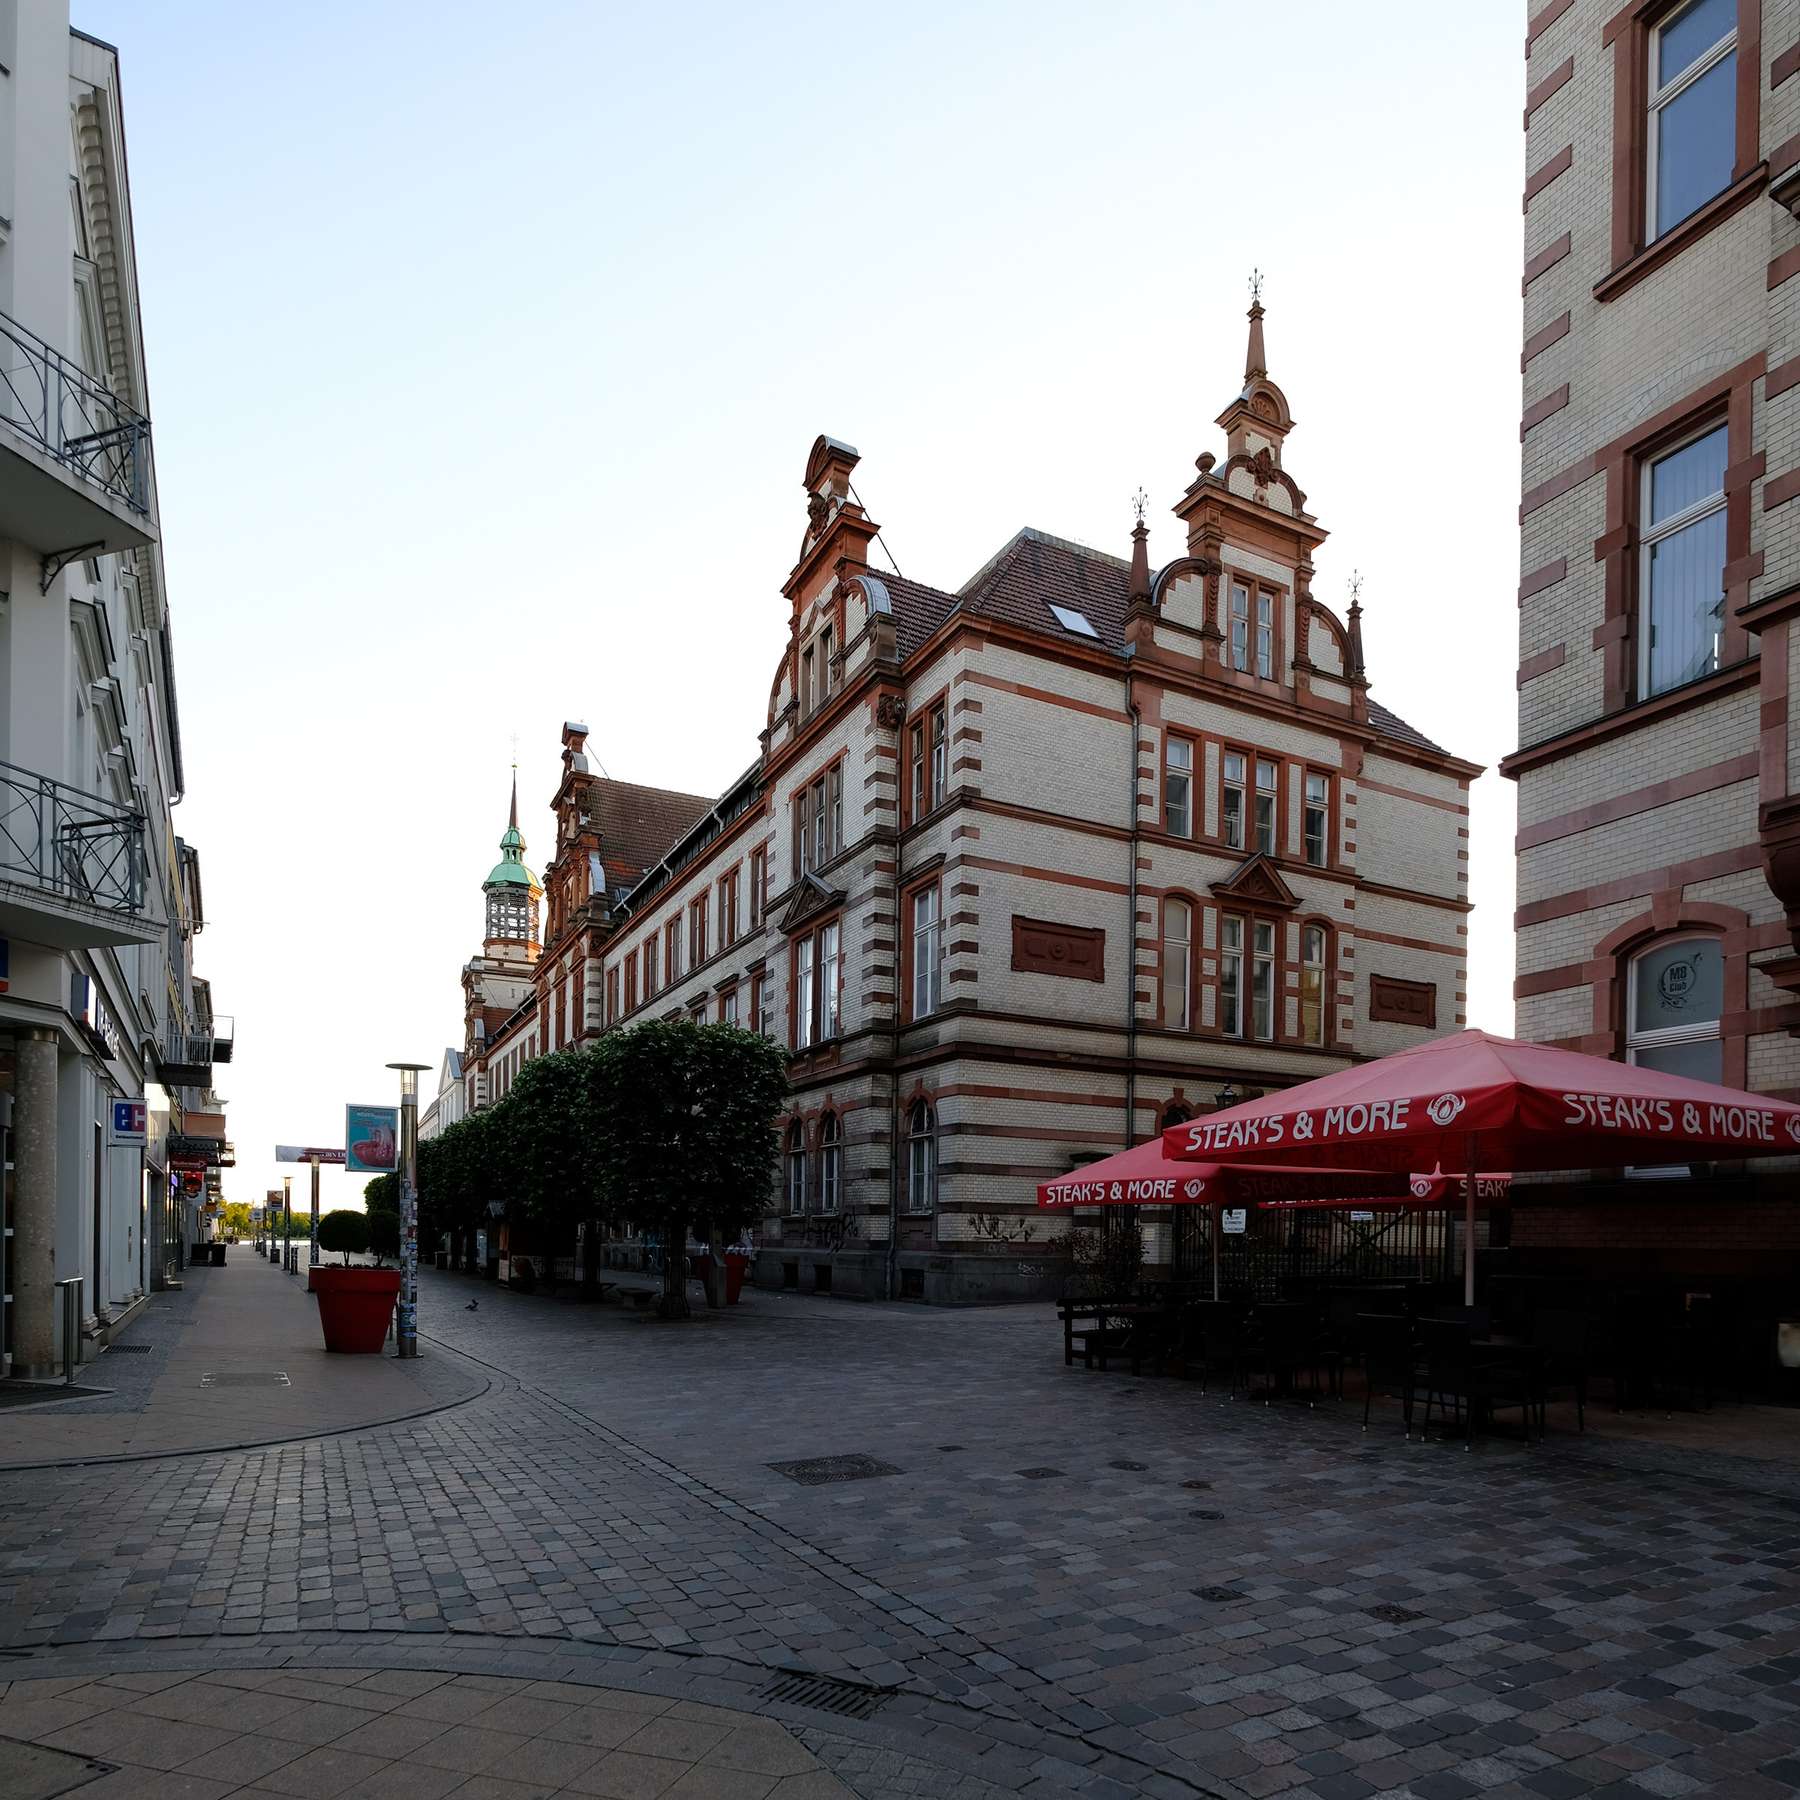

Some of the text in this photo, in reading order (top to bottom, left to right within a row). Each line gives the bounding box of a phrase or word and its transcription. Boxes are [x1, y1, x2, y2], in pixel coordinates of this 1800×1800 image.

[1185, 1114, 1285, 1152] STEAK'S
[1293, 1110, 1314, 1141] &
[1323, 1098, 1412, 1137] MORE
[1562, 1093, 1776, 1141] STEAK'S & MORE
[1045, 1179, 1177, 1204] STEAK'S & MORE
